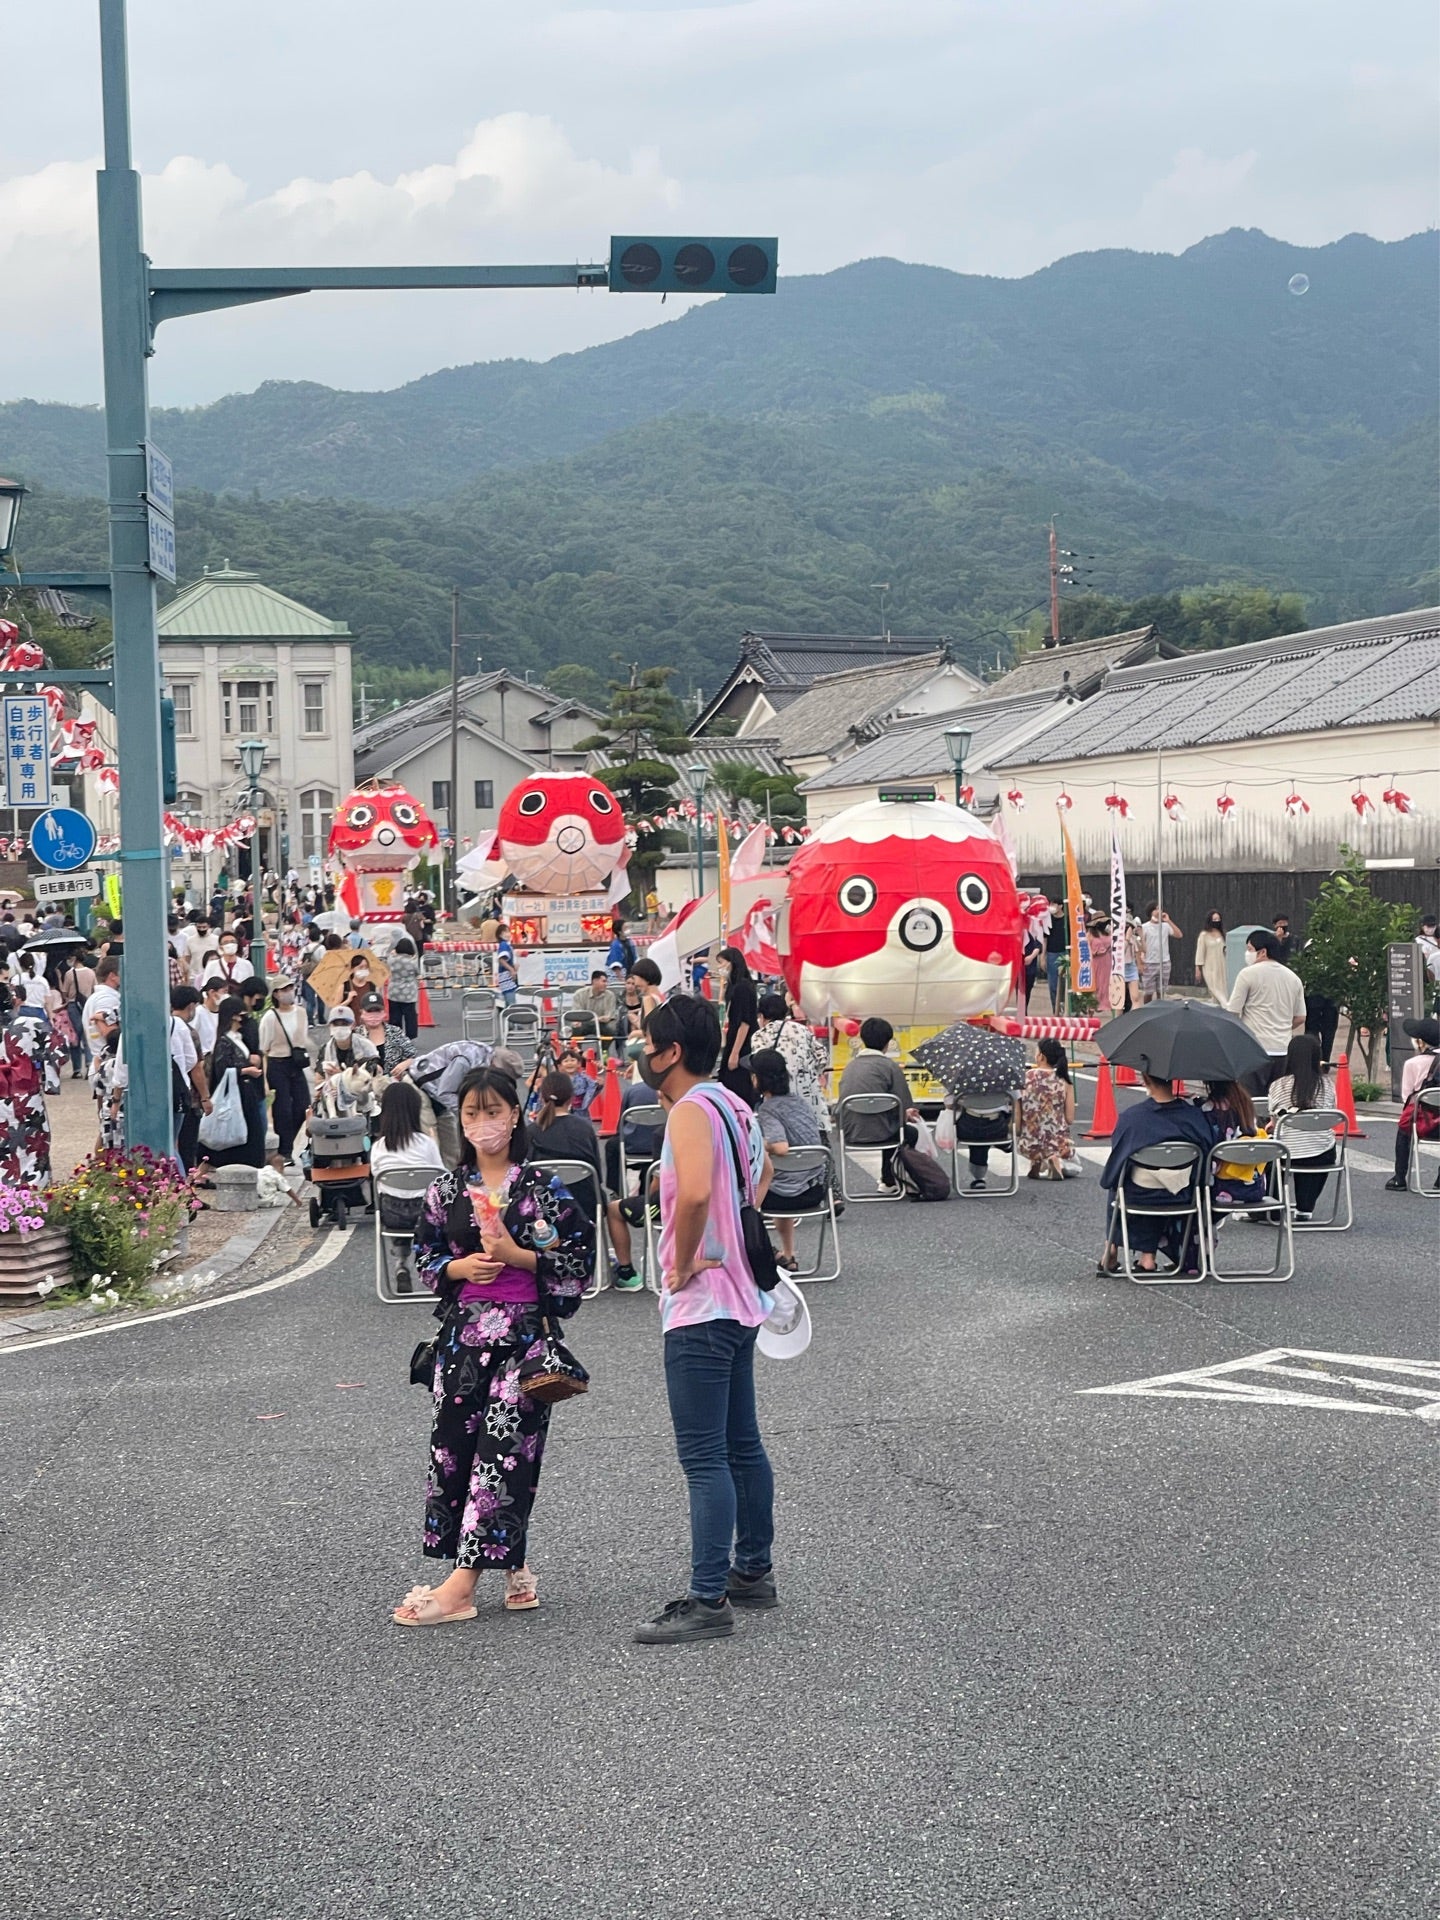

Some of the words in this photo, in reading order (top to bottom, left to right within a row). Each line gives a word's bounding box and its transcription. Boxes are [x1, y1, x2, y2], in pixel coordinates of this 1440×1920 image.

[9, 706, 26, 760] 自転車
[27, 705, 44, 760] 歩行者
[20, 763, 36, 799] 専用
[39, 878, 93, 895] 自転車通行可
[548, 923, 569, 934] JCI
[546, 970, 589, 981] GOALS
